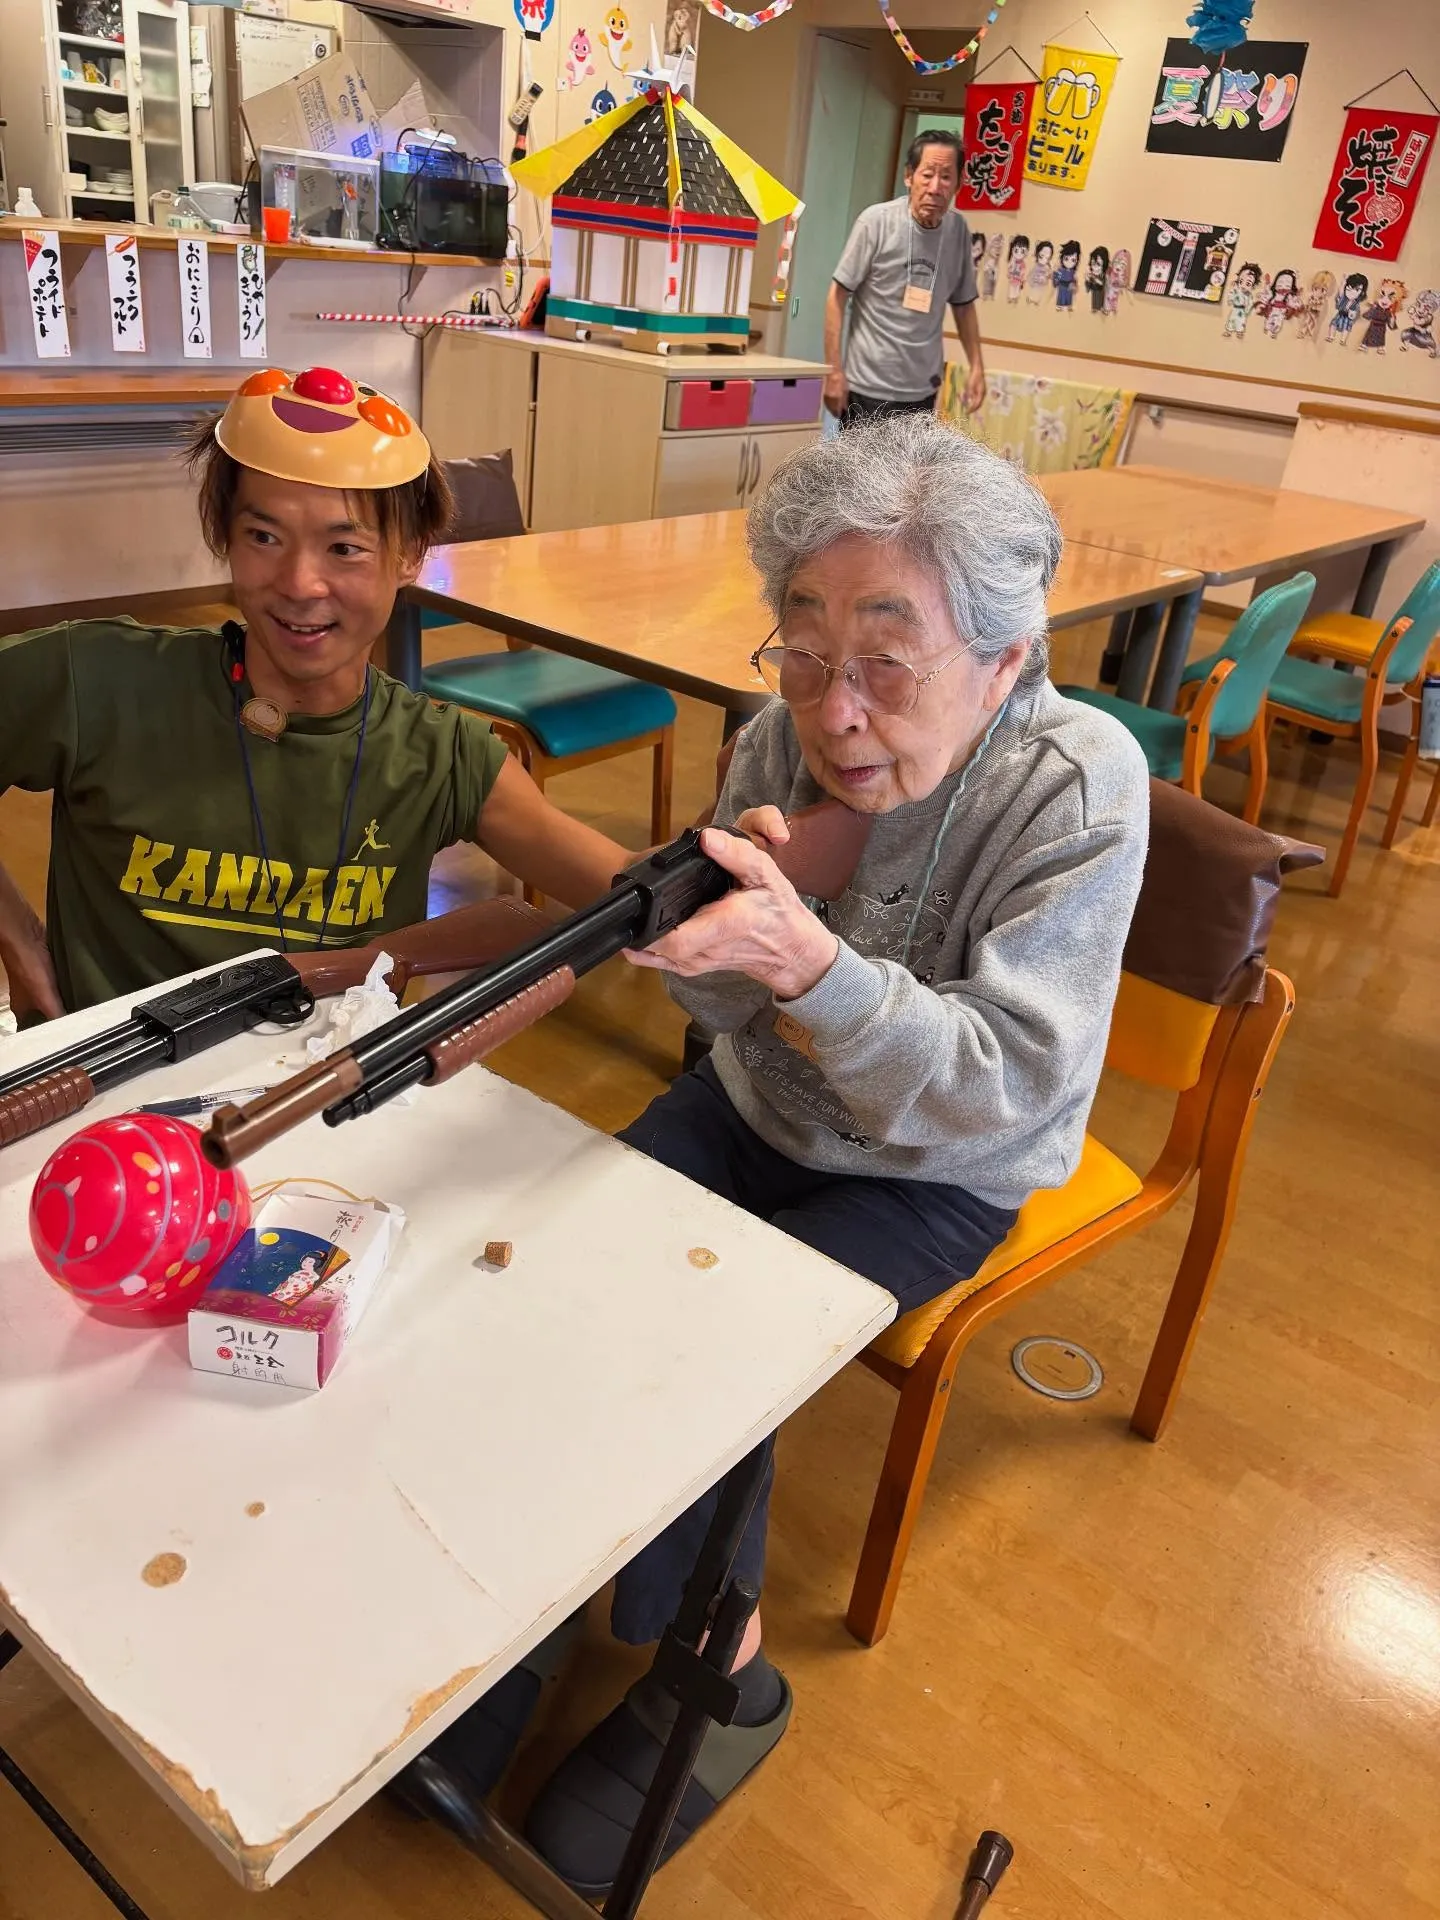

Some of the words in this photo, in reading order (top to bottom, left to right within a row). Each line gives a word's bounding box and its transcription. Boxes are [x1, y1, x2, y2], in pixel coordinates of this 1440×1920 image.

[1151, 65, 1299, 131] 夏祭り
[1029, 135, 1084, 165] ビール
[1333, 124, 1399, 249] 焼きそば
[33, 279, 49, 338] ポテト
[41, 249, 65, 319] フライド
[122, 255, 138, 321] フランク
[186, 242, 202, 326] おにぎり
[113, 297, 127, 335] フルト
[119, 834, 398, 926] KANDAEN
[886, 932, 933, 954] god
[789, 1083, 816, 1103] HAVE
[816, 1099, 839, 1116] FUN
[216, 1325, 280, 1350] コルク
